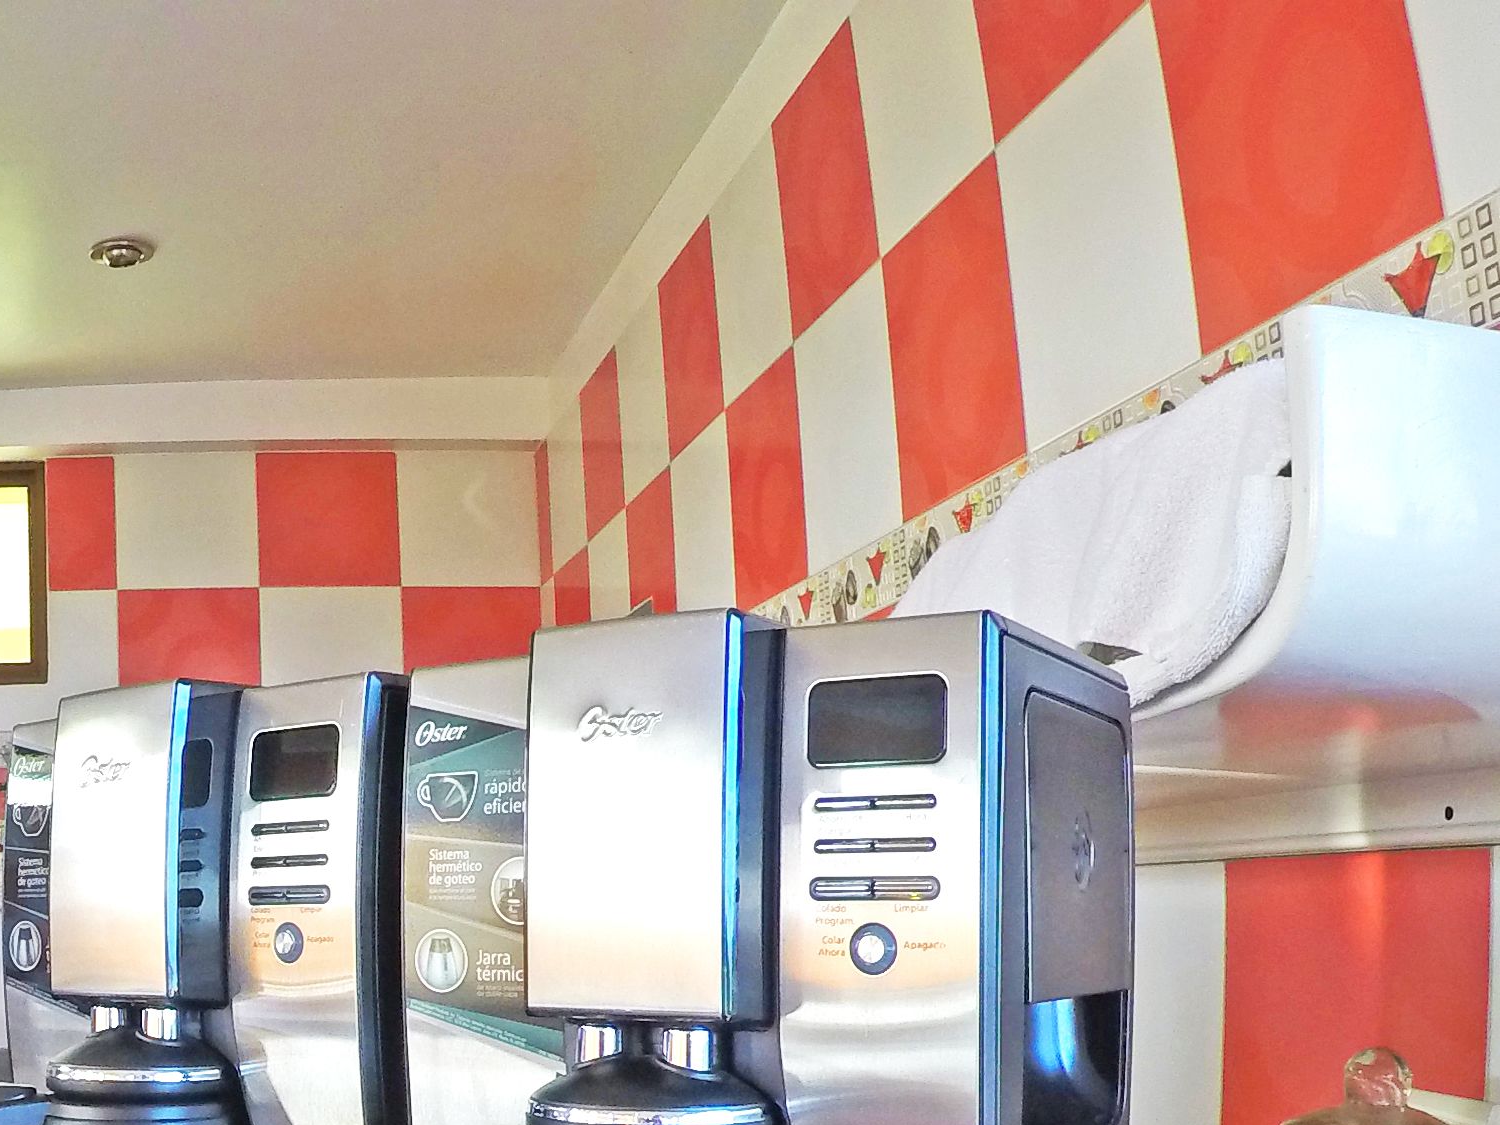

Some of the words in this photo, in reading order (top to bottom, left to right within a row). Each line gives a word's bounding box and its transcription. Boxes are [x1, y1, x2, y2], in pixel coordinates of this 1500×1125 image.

[415, 720, 468, 747] Oster
[428, 848, 470, 861] Sistema
[428, 860, 483, 873] hermético
[428, 872, 442, 885] de
[443, 874, 476, 888] goteo
[475, 949, 512, 966] Jarra
